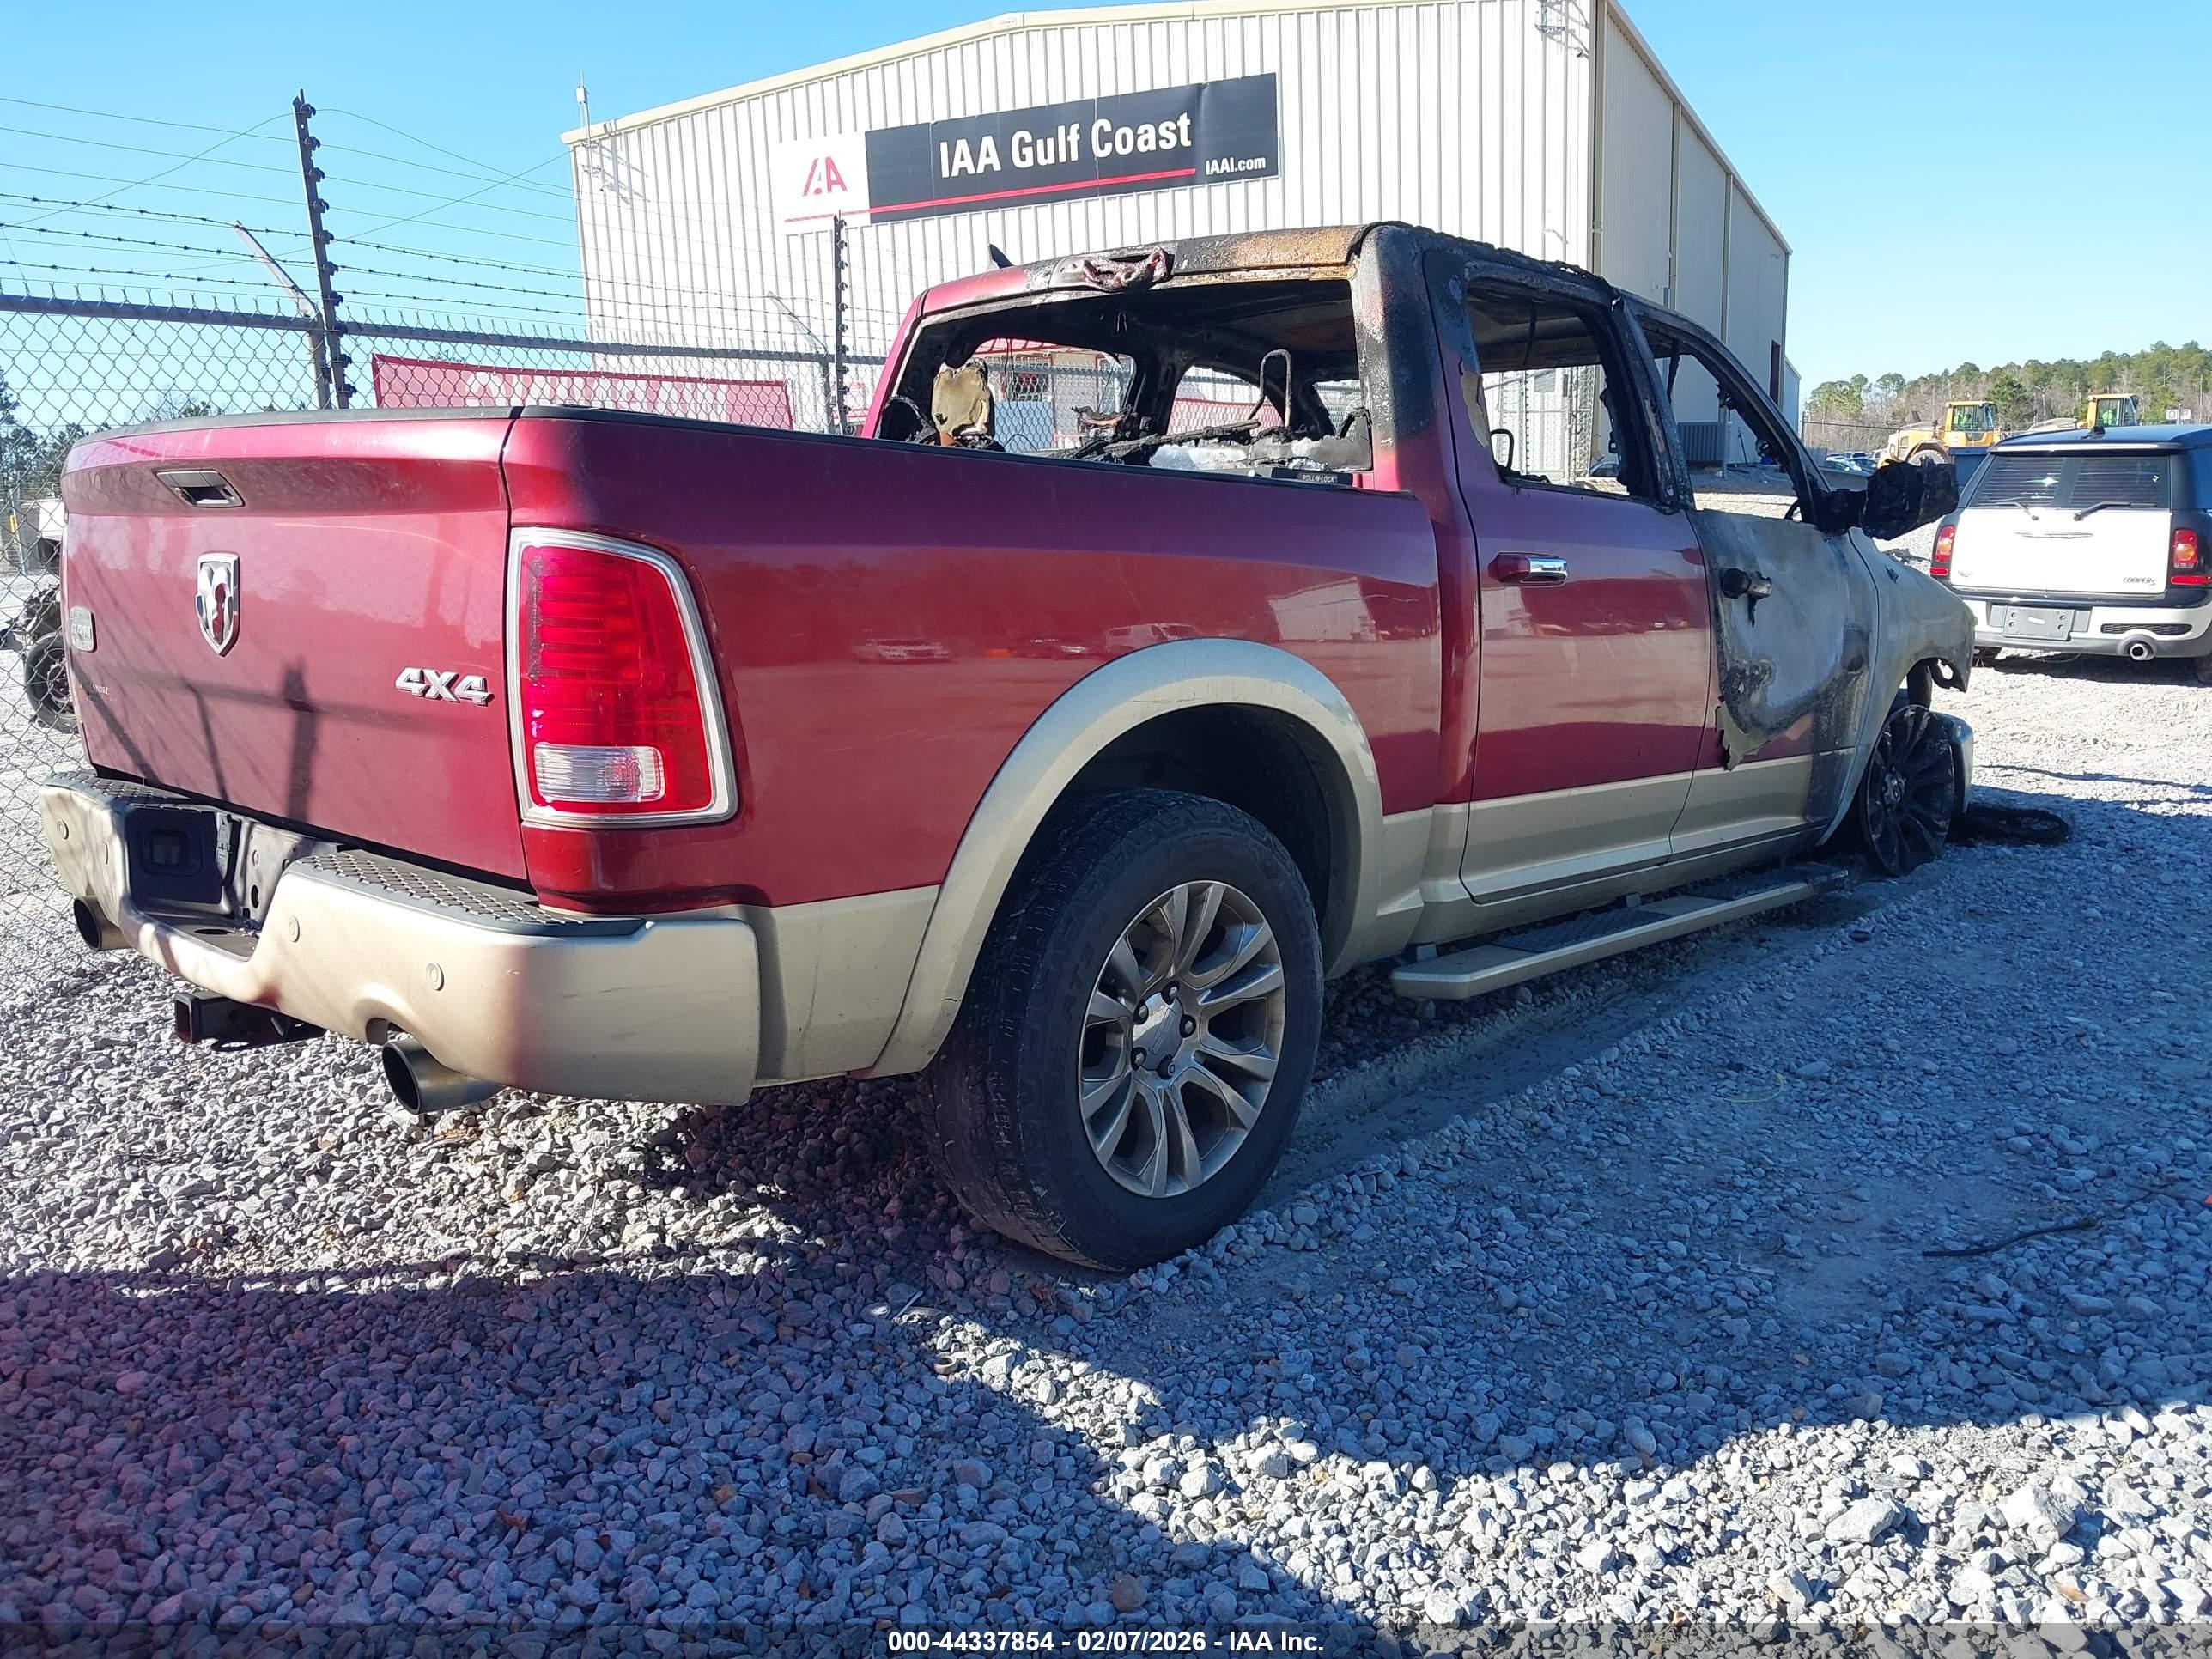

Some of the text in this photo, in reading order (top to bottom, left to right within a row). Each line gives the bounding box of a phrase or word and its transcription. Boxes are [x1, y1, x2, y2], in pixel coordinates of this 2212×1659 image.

[939, 112, 1192, 179] IAA Gulf Coast
[1206, 156, 1267, 175] IAAI.com
